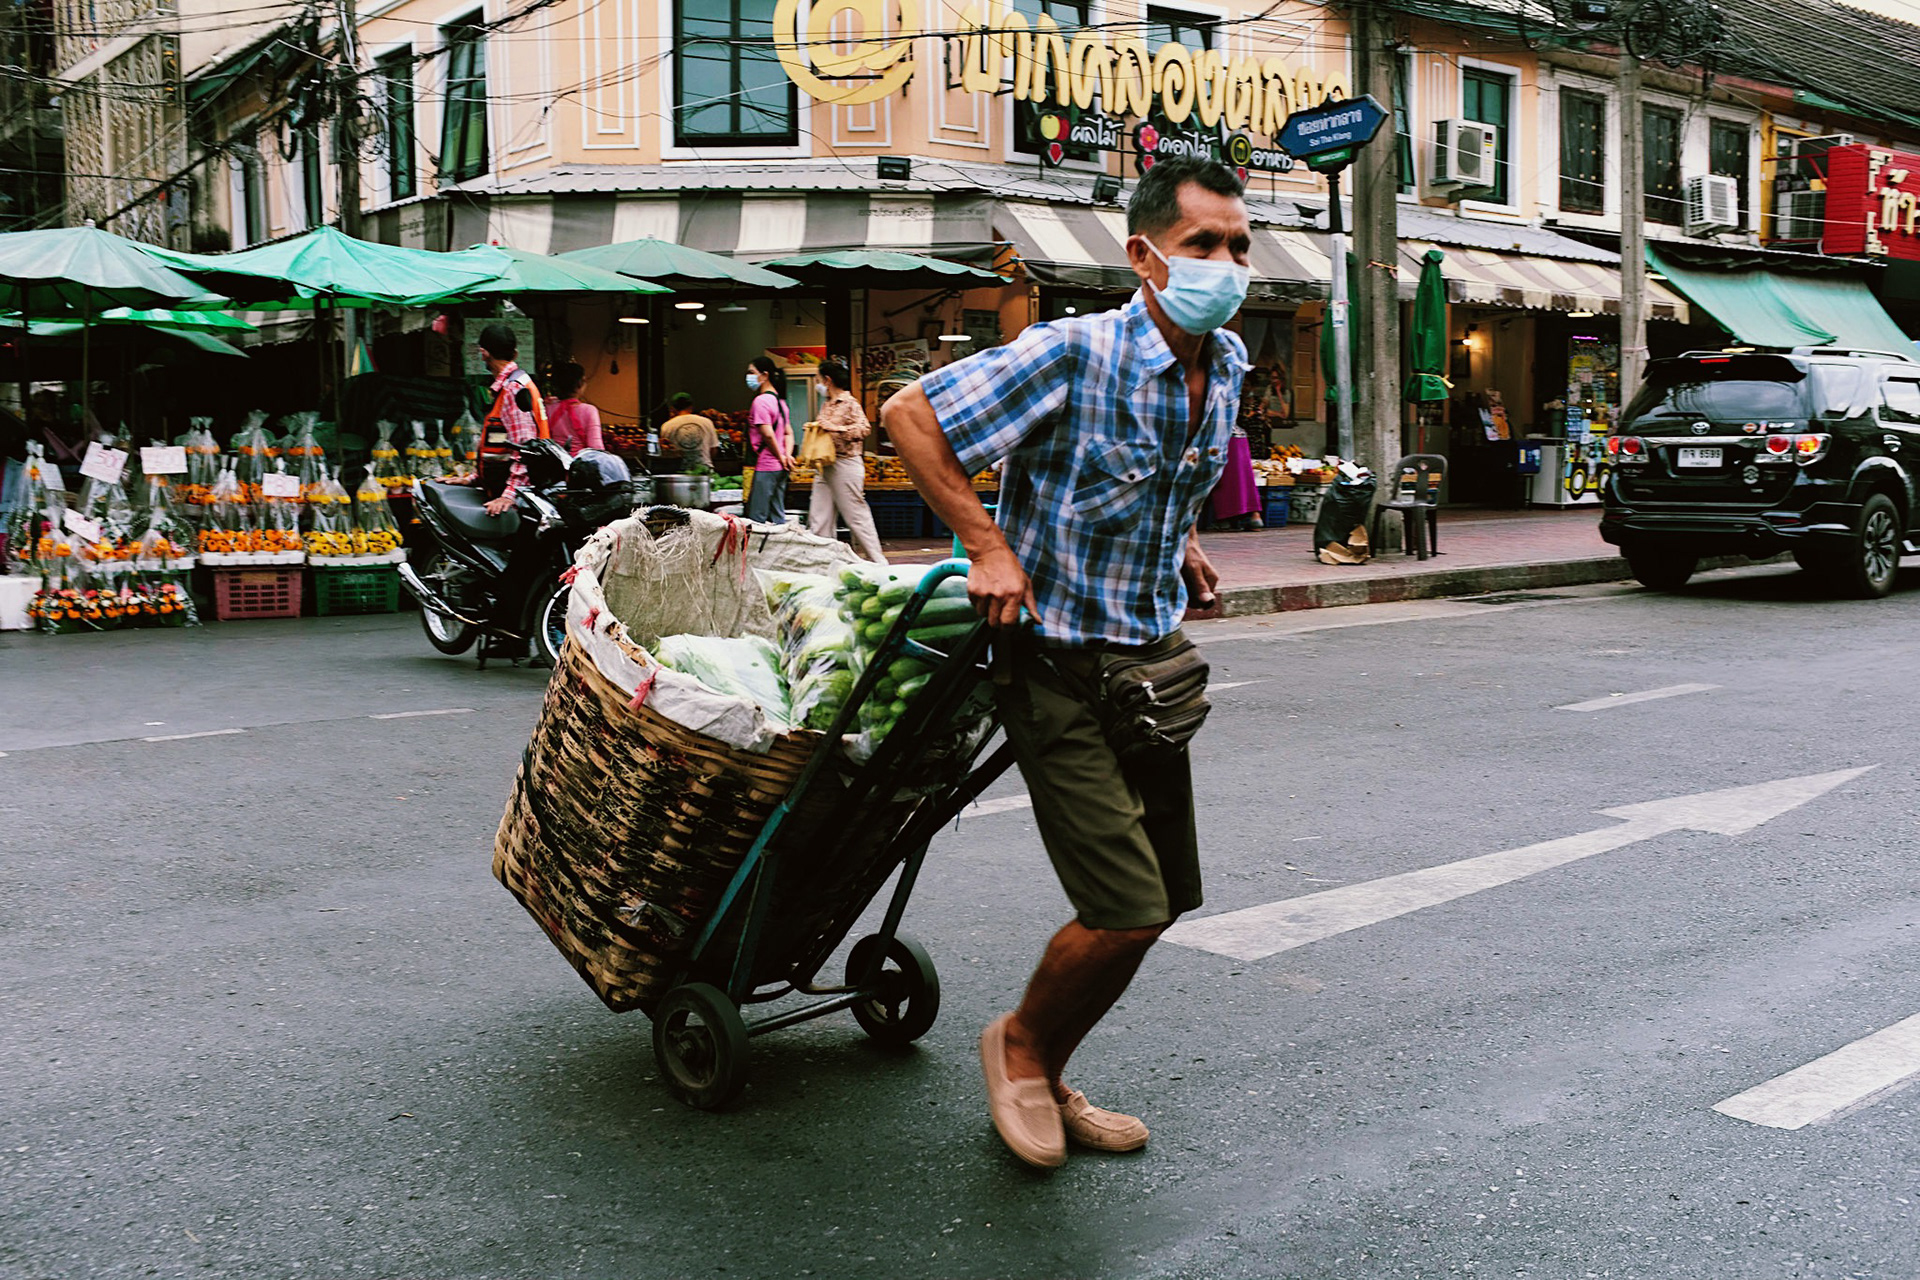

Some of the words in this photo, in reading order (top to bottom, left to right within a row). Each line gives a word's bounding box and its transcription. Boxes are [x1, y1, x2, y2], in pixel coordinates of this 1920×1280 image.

[1070, 116, 1124, 147] ผลไม้
[1158, 132, 1218, 159] ดอกไม้
[1250, 150, 1294, 170] อาหาร
